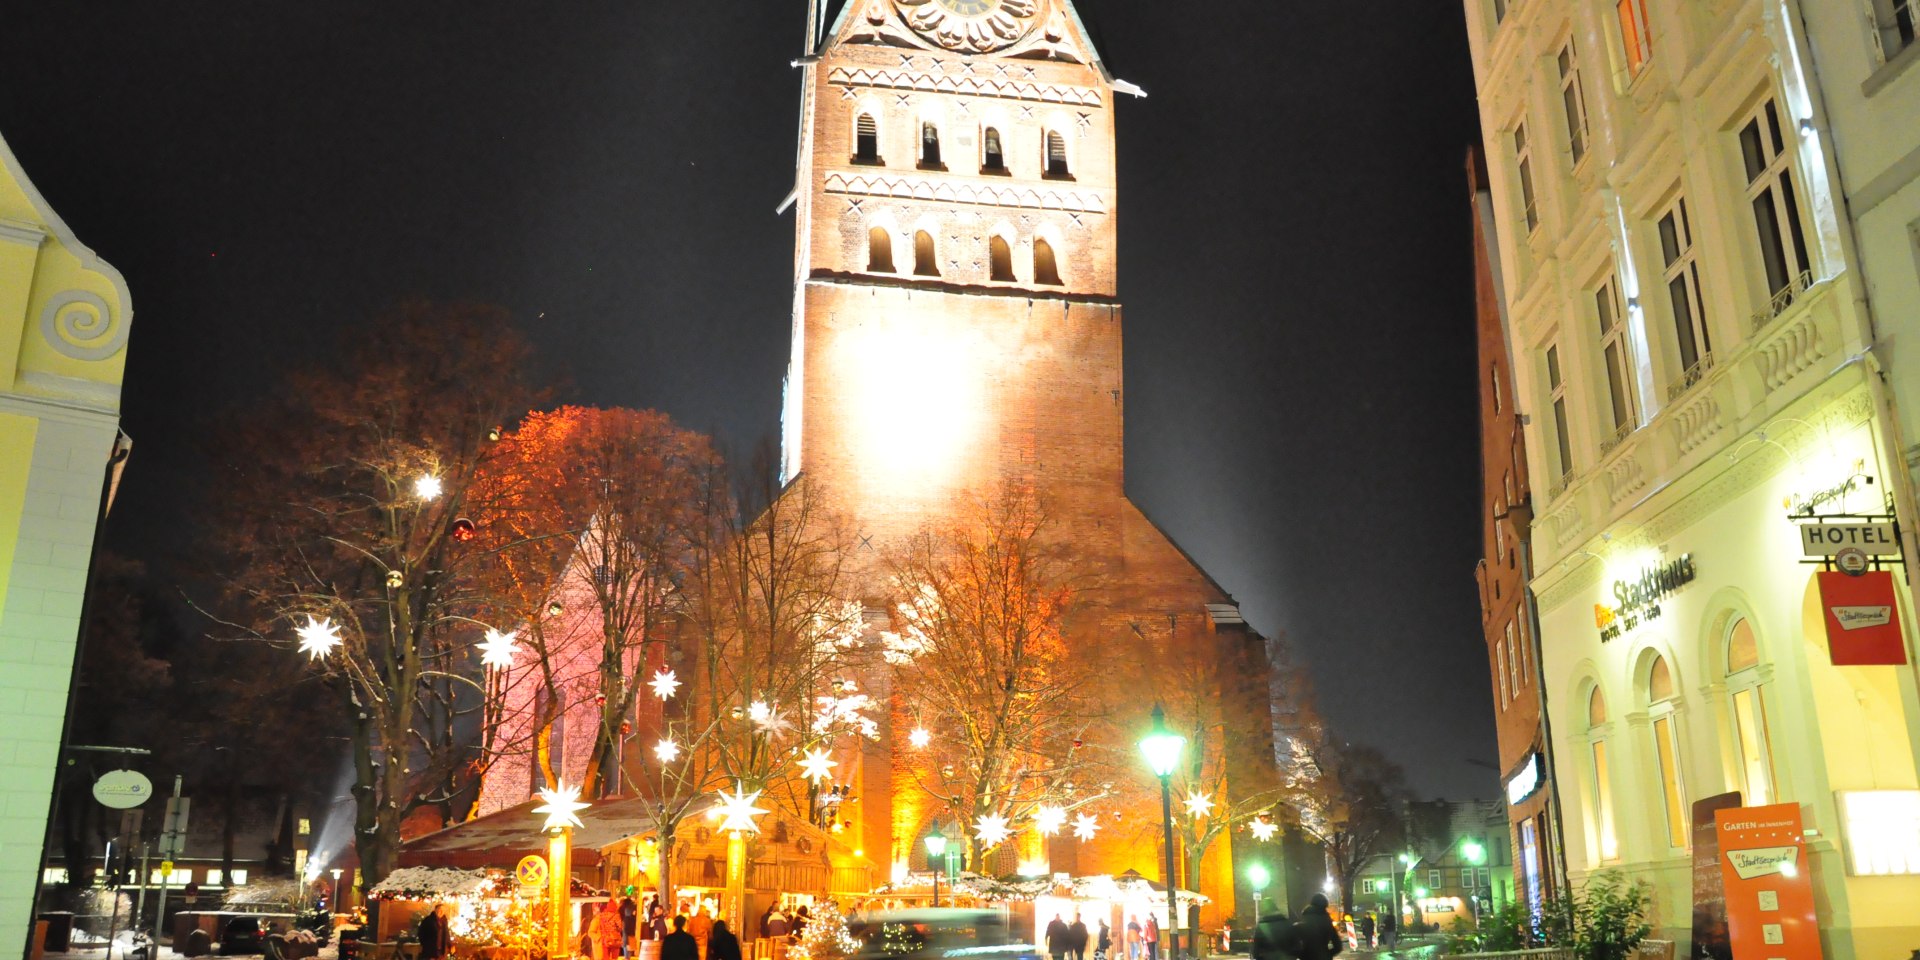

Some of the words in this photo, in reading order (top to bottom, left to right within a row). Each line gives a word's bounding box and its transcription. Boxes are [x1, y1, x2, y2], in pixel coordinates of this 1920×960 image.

[1808, 527, 1890, 544] HOTEL
[1613, 553, 1694, 616] Stadthaus
[1723, 822, 1757, 831] GARTEN
